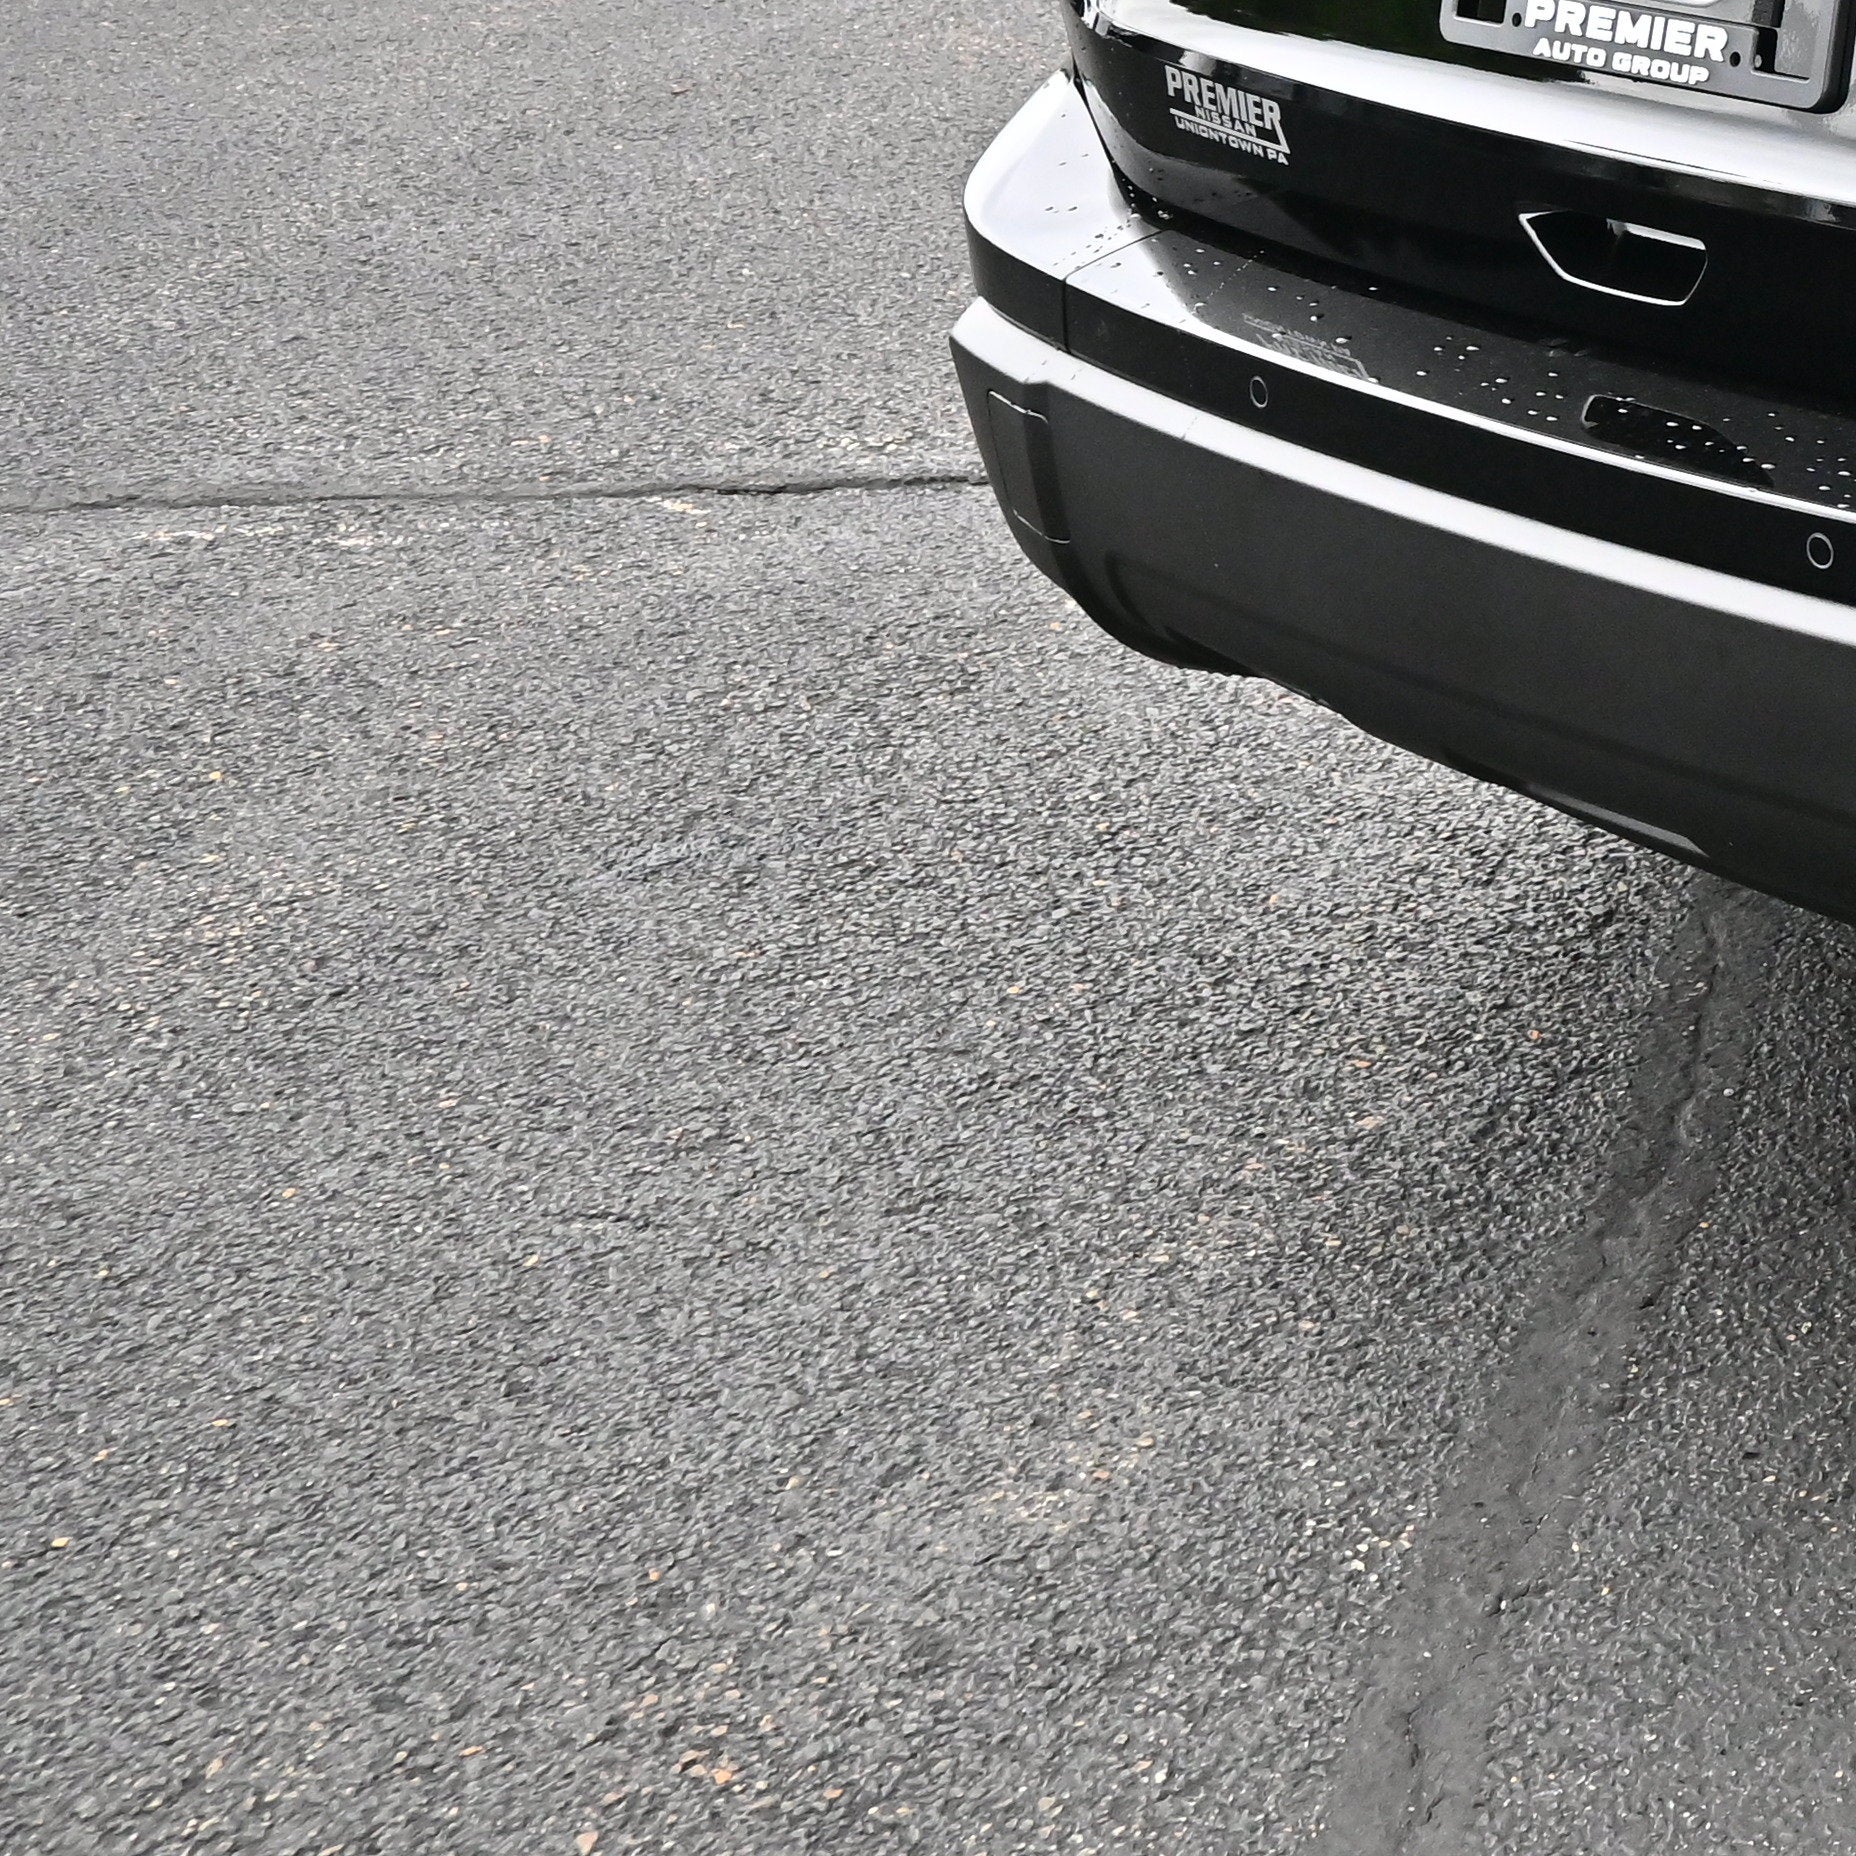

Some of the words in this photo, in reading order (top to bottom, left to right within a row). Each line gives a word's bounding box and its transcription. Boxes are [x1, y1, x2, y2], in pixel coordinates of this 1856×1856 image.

[1532, 38, 1607, 68] AUTO
[1612, 52, 1710, 85] GROUP
[1164, 65, 1282, 131] PREMIER
[1194, 105, 1258, 138] NISSAN
[1174, 116, 1265, 158] UNIONTOWN
[1266, 148, 1290, 166] PA
